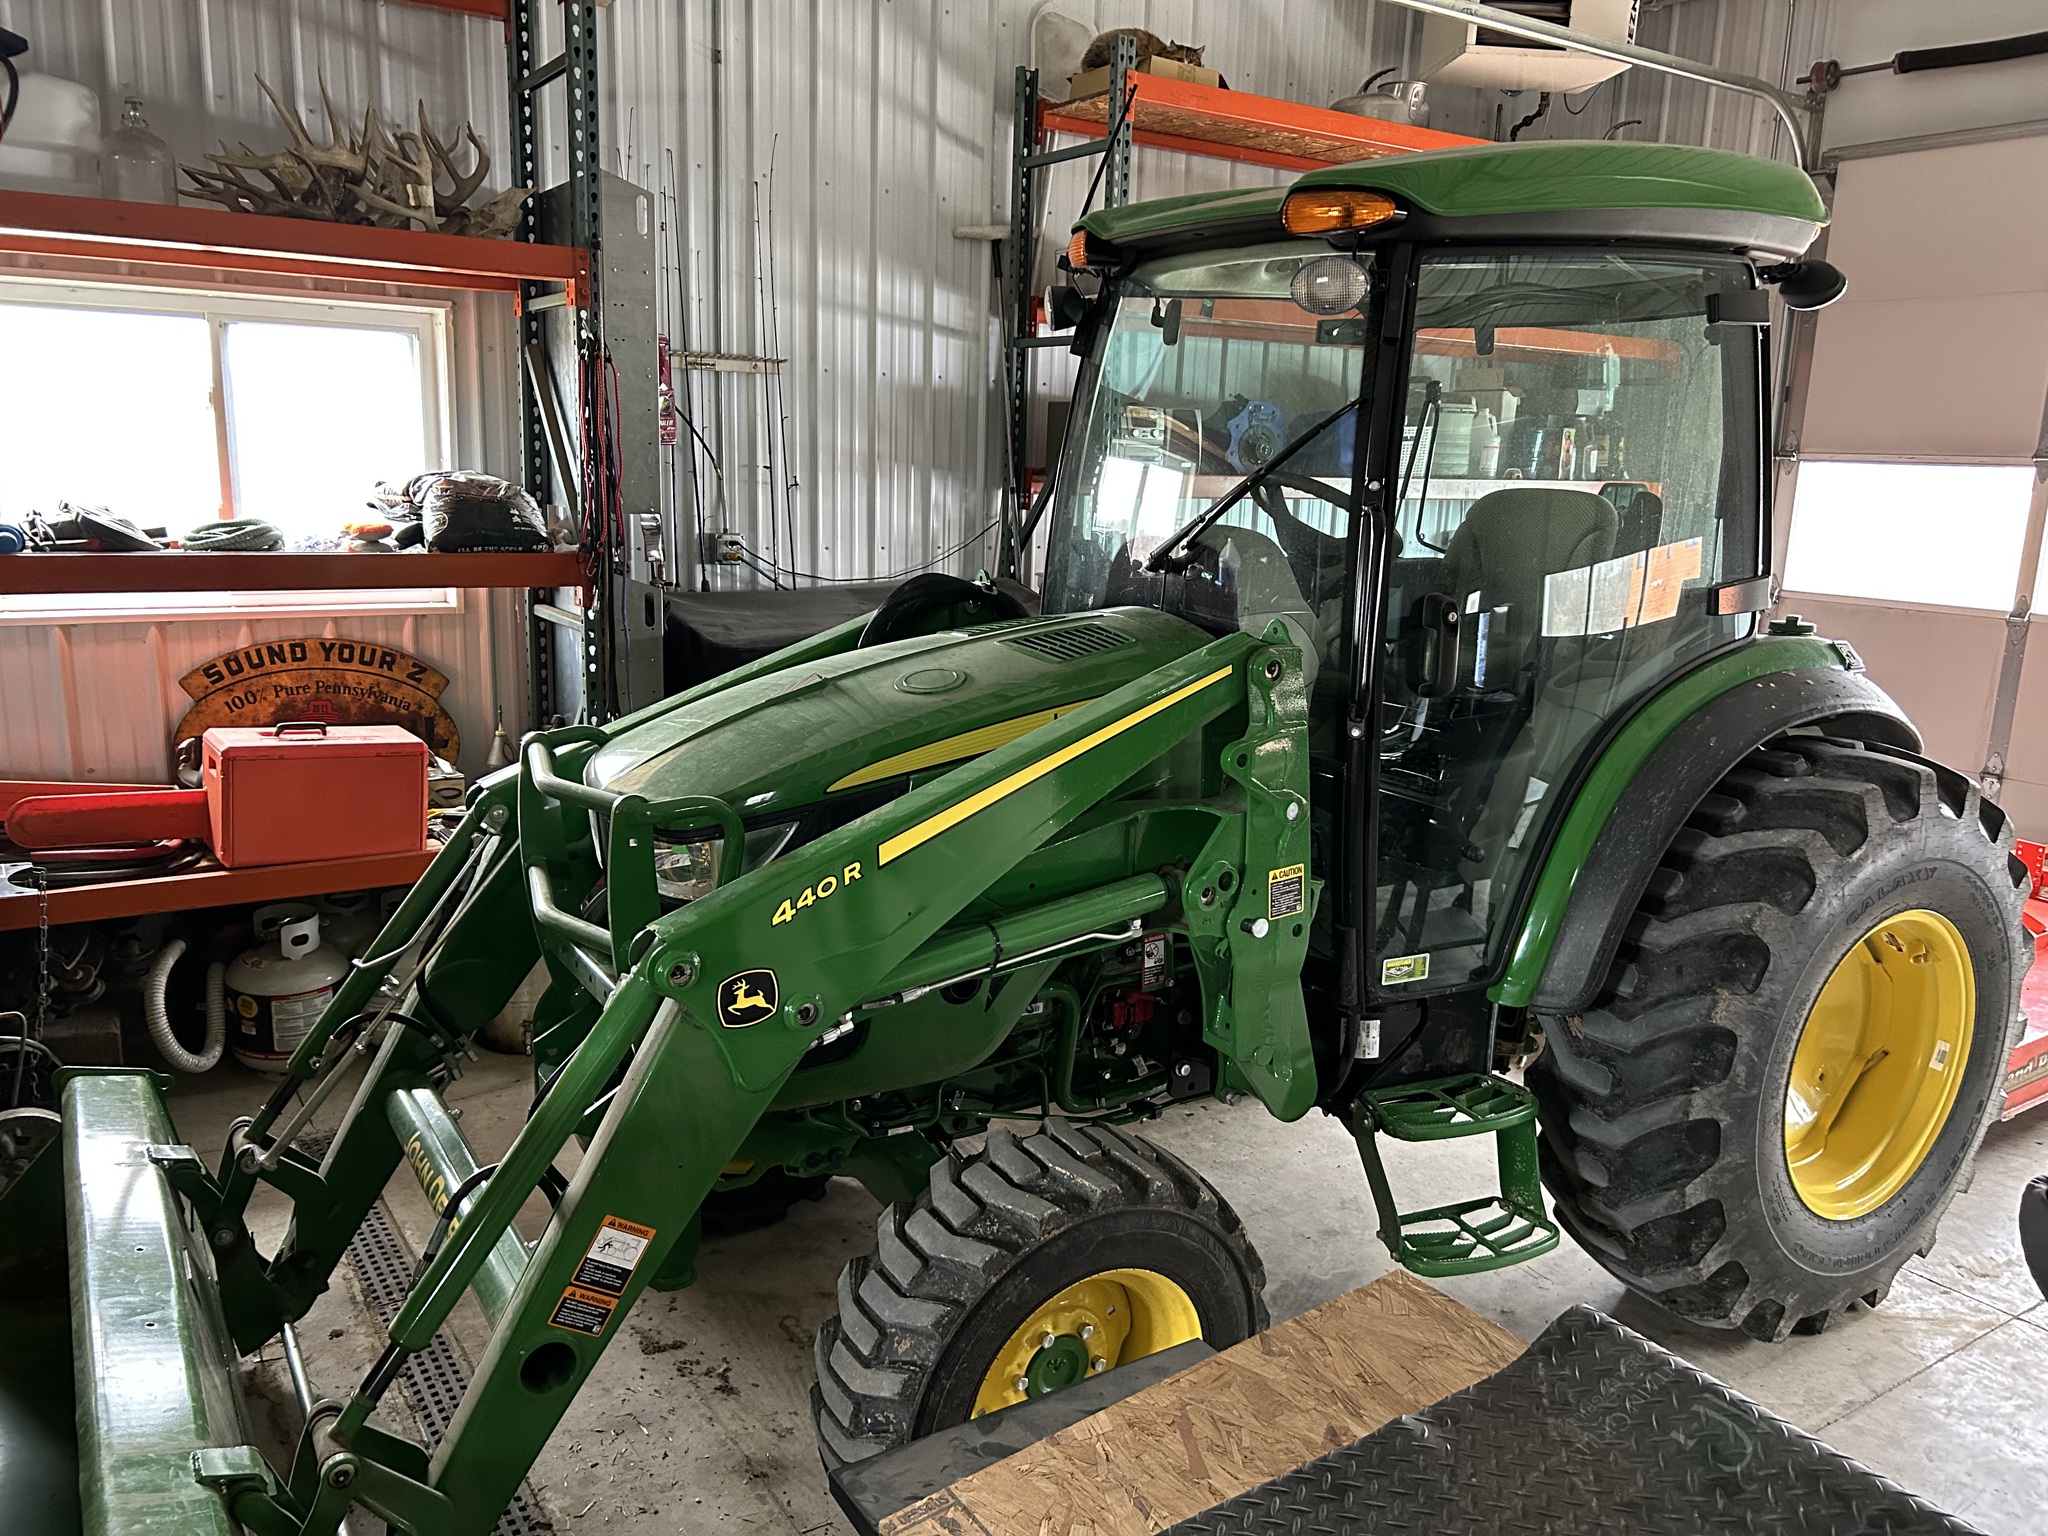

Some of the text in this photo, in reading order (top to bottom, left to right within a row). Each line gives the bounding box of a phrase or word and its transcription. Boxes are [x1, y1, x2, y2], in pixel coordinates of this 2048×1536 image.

[202, 642, 428, 686] SOUND YOUR Z
[223, 680, 413, 714] 100% Pure Pennsylvania
[1278, 866, 1303, 879] CAUTION
[404, 1130, 435, 1191] JOHN
[617, 1221, 650, 1237] WARNING
[579, 1292, 612, 1307] WARNING
